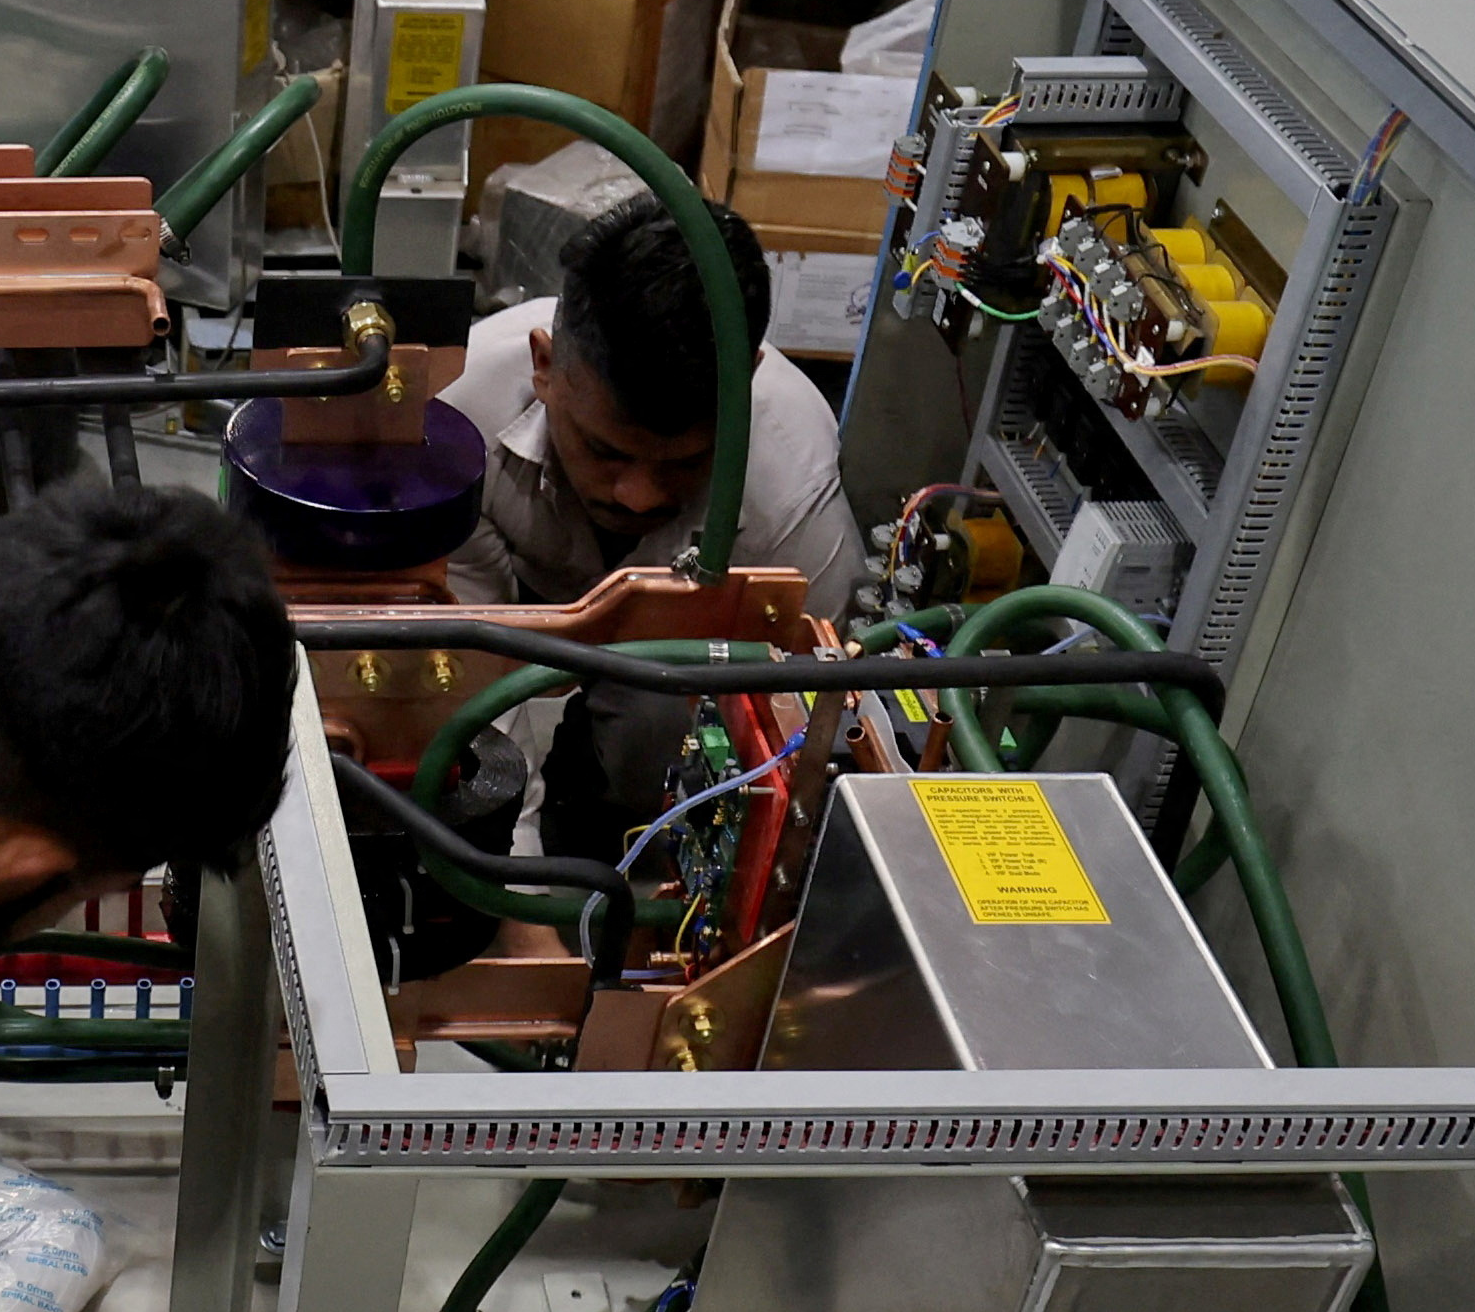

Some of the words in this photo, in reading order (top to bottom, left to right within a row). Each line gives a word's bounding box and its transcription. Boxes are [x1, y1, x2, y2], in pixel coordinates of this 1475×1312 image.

[41, 1245, 80, 1260] 6.0mm
[25, 1255, 61, 1269] SPIRAL
[16, 1281, 55, 1299] 6.0mm
[1, 1290, 36, 1306] SPIRAL
